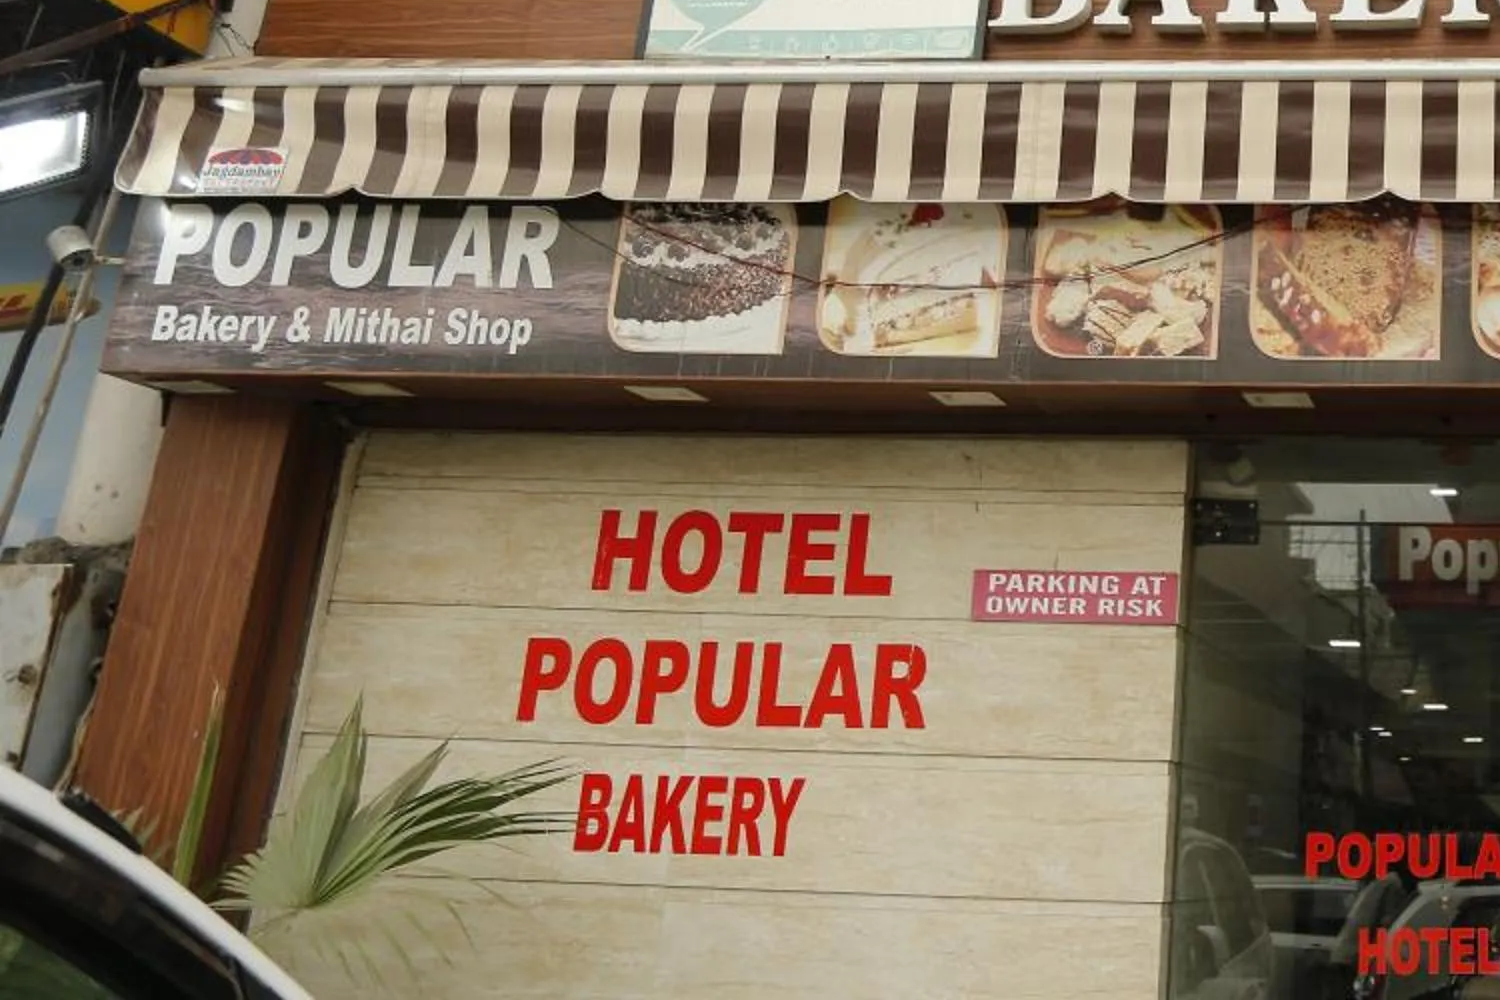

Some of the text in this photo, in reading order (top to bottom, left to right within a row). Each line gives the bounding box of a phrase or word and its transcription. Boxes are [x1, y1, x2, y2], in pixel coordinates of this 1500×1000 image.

[153, 203, 560, 289] POPULAR
[152, 305, 534, 355] Bakery & Mithai Shop
[591, 508, 894, 597] HOTEL
[987, 572, 1168, 597] PARKING AT
[985, 595, 1165, 618] OWNER RISK
[515, 637, 928, 730] POPULAR
[572, 773, 806, 858] BAKERY
